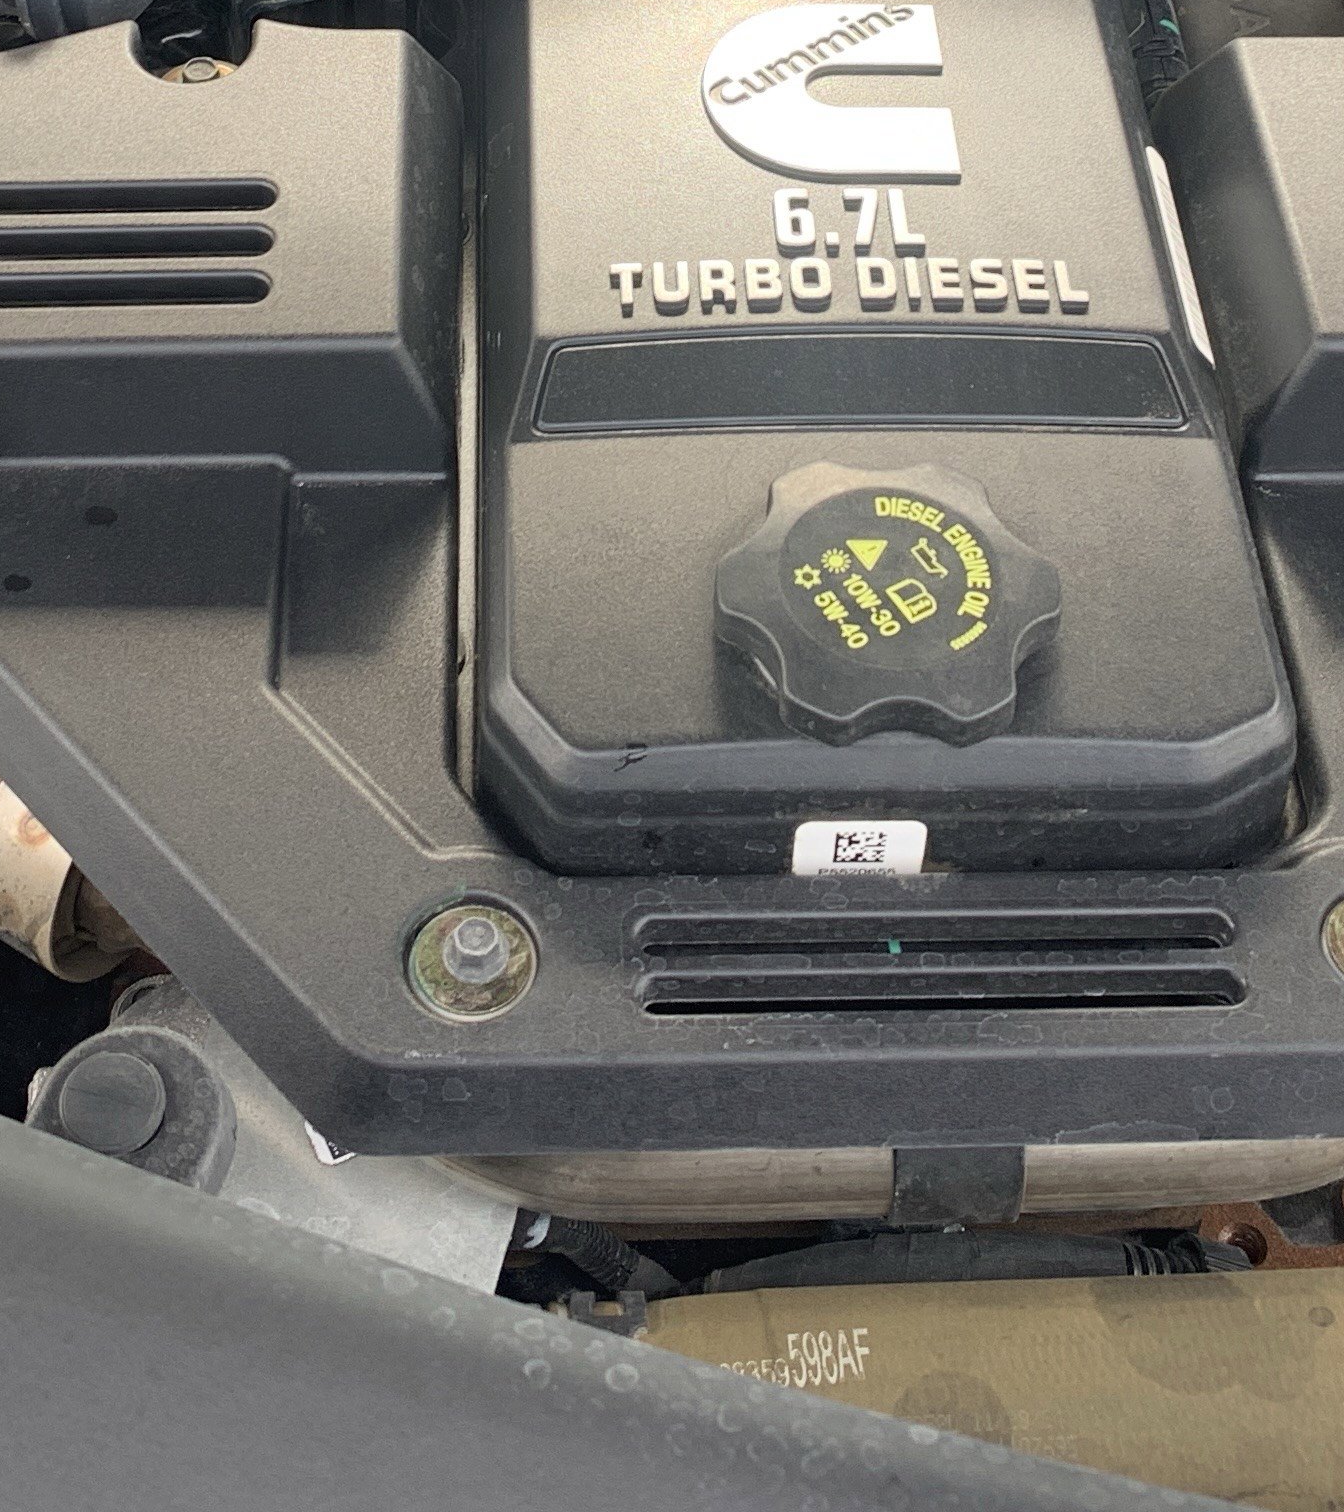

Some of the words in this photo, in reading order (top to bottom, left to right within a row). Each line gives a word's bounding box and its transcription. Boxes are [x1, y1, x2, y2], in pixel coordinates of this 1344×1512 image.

[710, 1, 914, 107] Cummins
[773, 187, 926, 255] 6.7L
[610, 258, 832, 316] TURBO
[856, 257, 1089, 315] DIESEL
[875, 496, 946, 532] DIESEL
[942, 523, 992, 589] ENGINE
[814, 590, 869, 649] 5W-40
[843, 573, 901, 637] 10W-30
[957, 591, 991, 618] OIL
